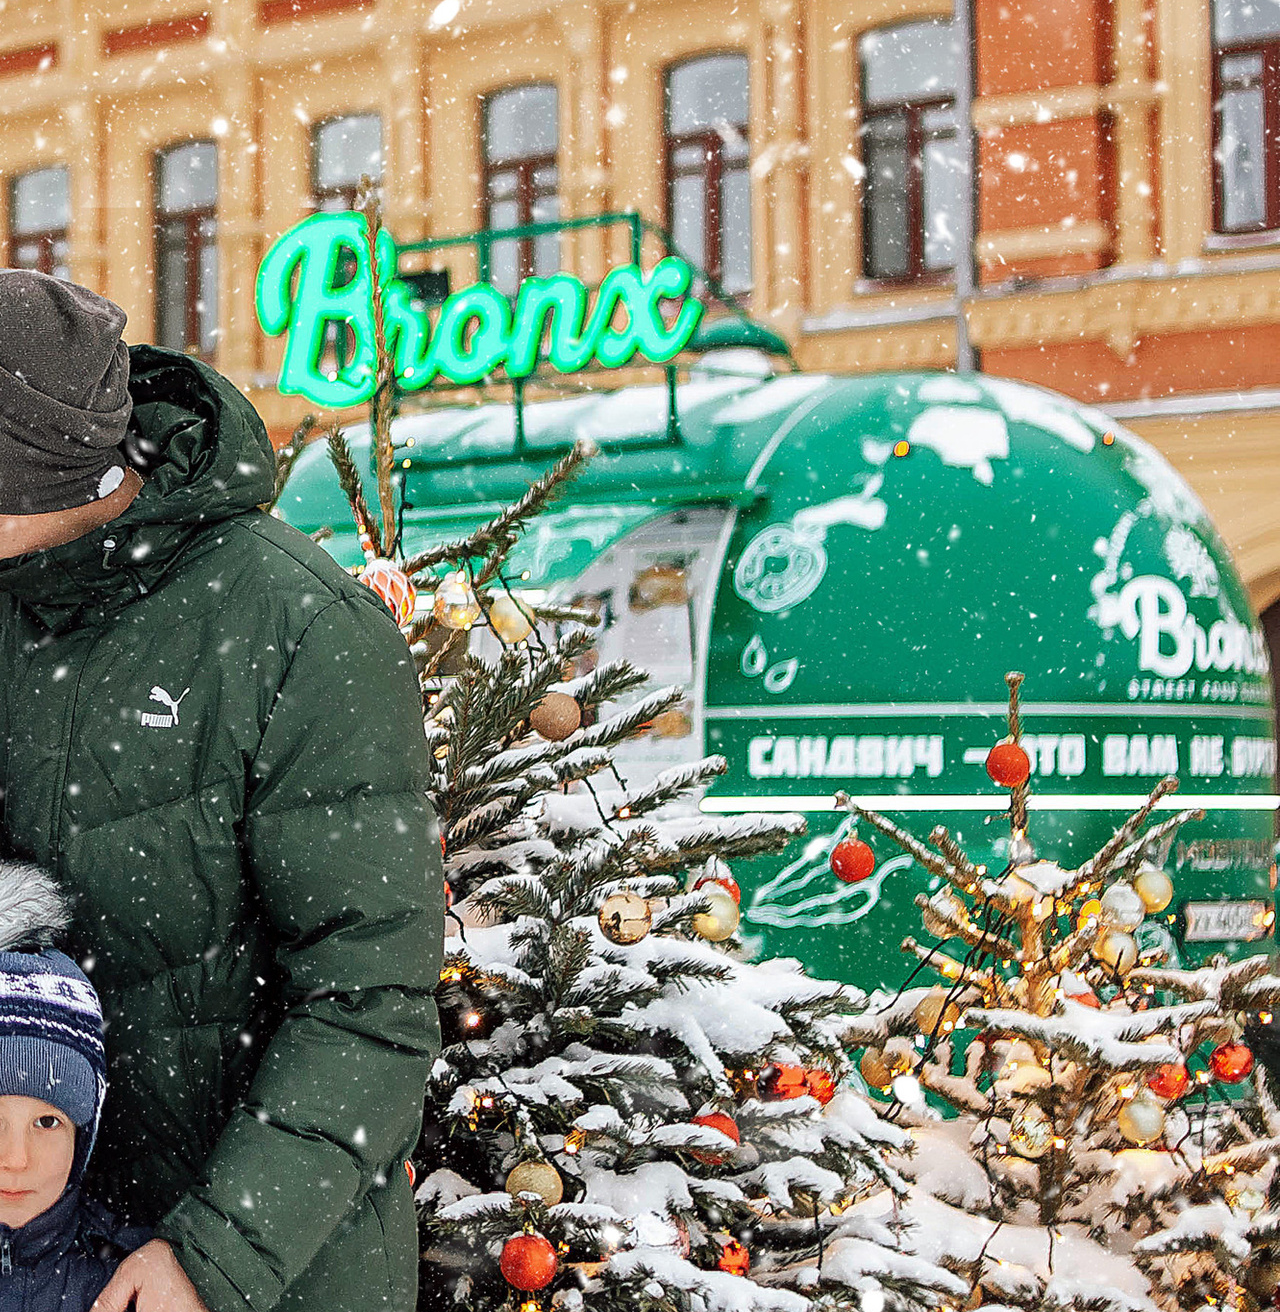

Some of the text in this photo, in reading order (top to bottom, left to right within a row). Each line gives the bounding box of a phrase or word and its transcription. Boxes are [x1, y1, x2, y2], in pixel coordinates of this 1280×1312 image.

[256, 210, 704, 408] Bronx
[141, 712, 173, 728] PUMA
[748, 734, 944, 778] САНДВИЧ
[1102, 733, 1179, 777] ВАМ
